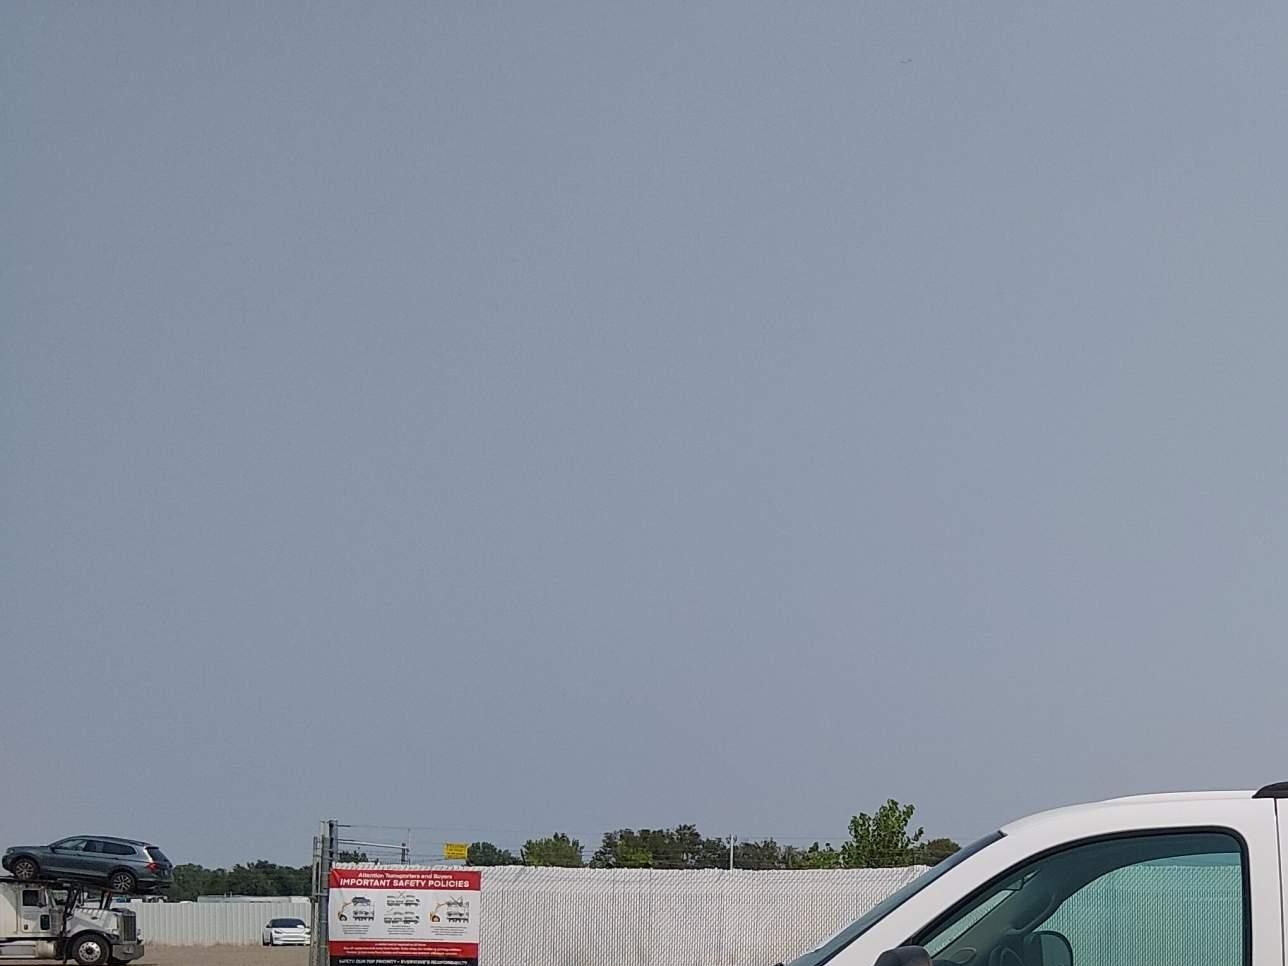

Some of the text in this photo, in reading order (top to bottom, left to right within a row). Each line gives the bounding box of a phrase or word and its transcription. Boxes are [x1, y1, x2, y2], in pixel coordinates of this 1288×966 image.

[340, 878, 470, 888] IMPORTANT SAFETY POLICIES
